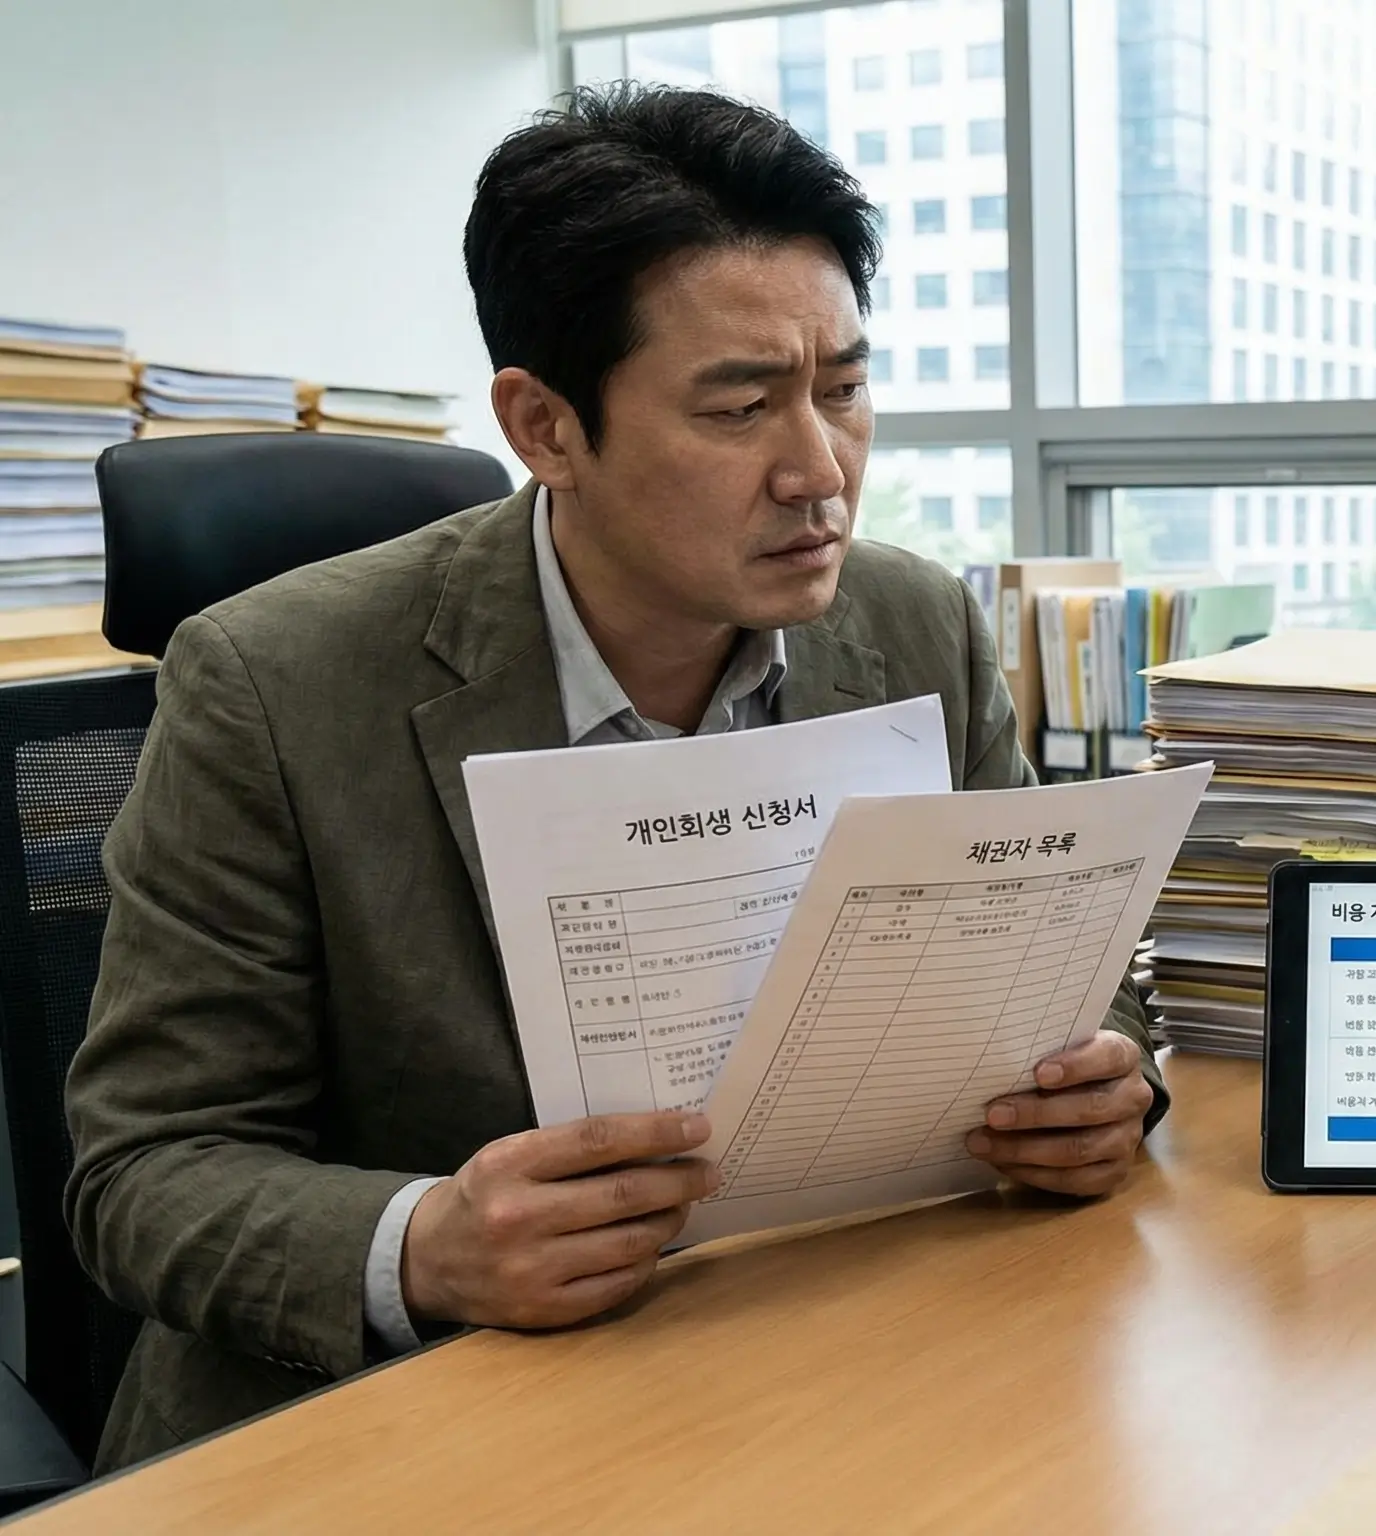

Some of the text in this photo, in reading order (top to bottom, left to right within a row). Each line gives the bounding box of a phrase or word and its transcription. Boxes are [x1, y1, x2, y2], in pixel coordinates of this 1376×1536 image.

[625, 793, 817, 846] 개인회생 신청서
[965, 832, 1077, 865] 채권자 목록
